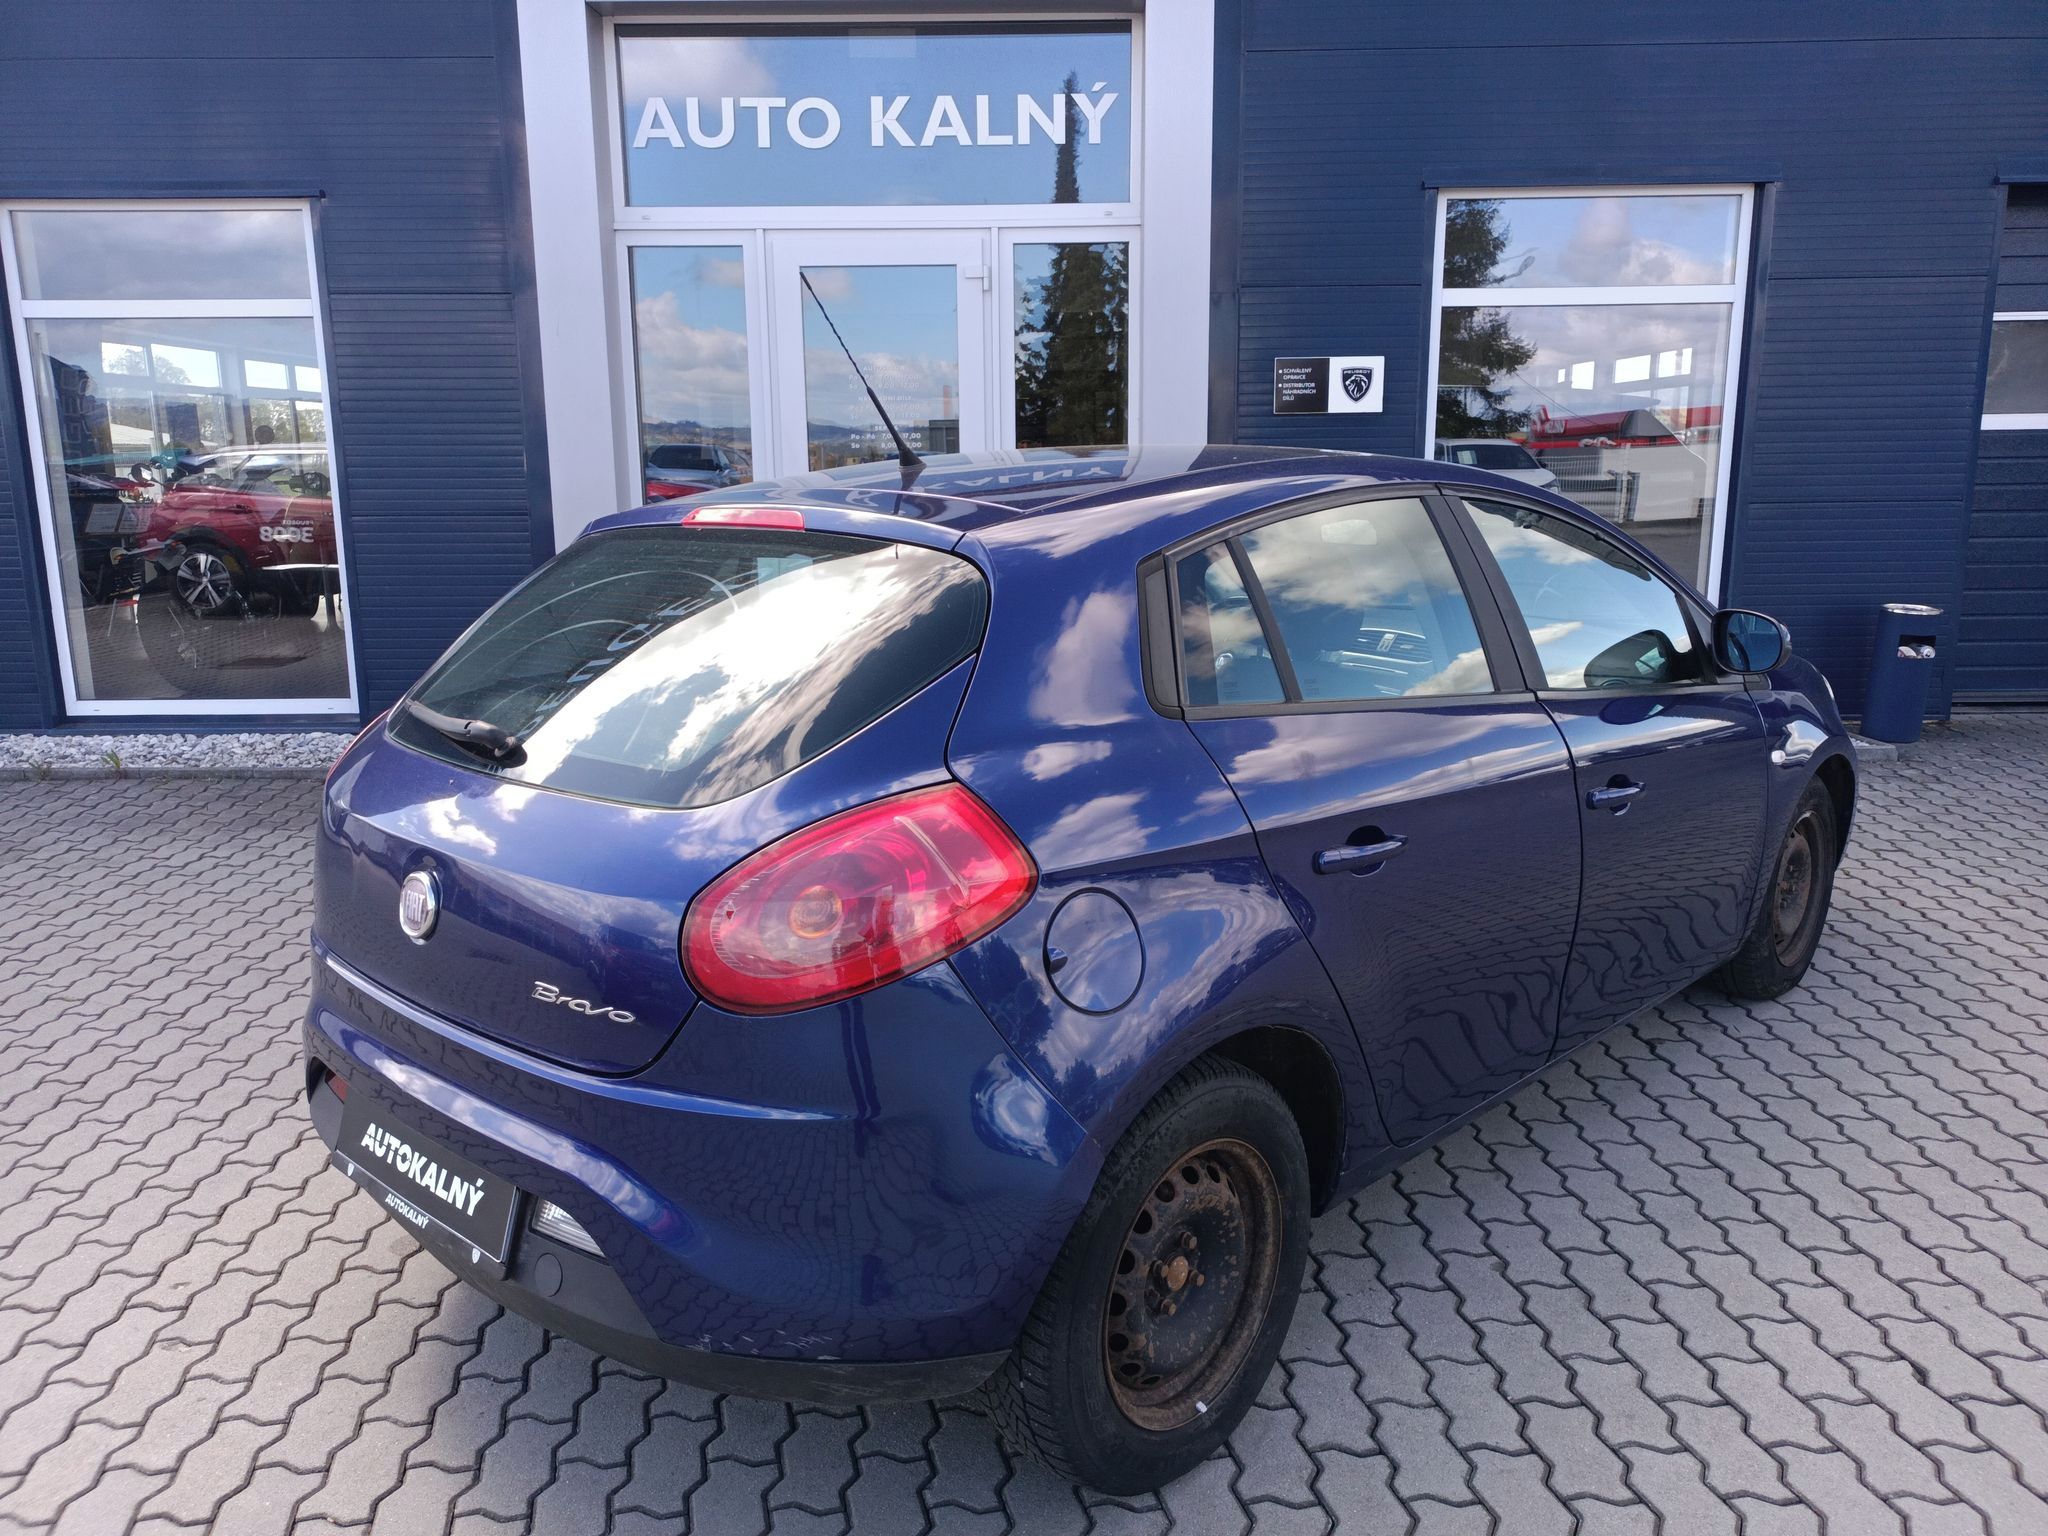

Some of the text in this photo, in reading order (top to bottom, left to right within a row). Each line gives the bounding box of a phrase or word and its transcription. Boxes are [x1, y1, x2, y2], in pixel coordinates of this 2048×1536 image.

[633, 82, 1119, 149] AUTO KALNÝ
[405, 889, 425, 922] FIAT
[531, 980, 637, 1023] Bravo
[361, 1122, 485, 1217] AUTOKALNÝ
[385, 1193, 429, 1229] AUTOKALNÝ
